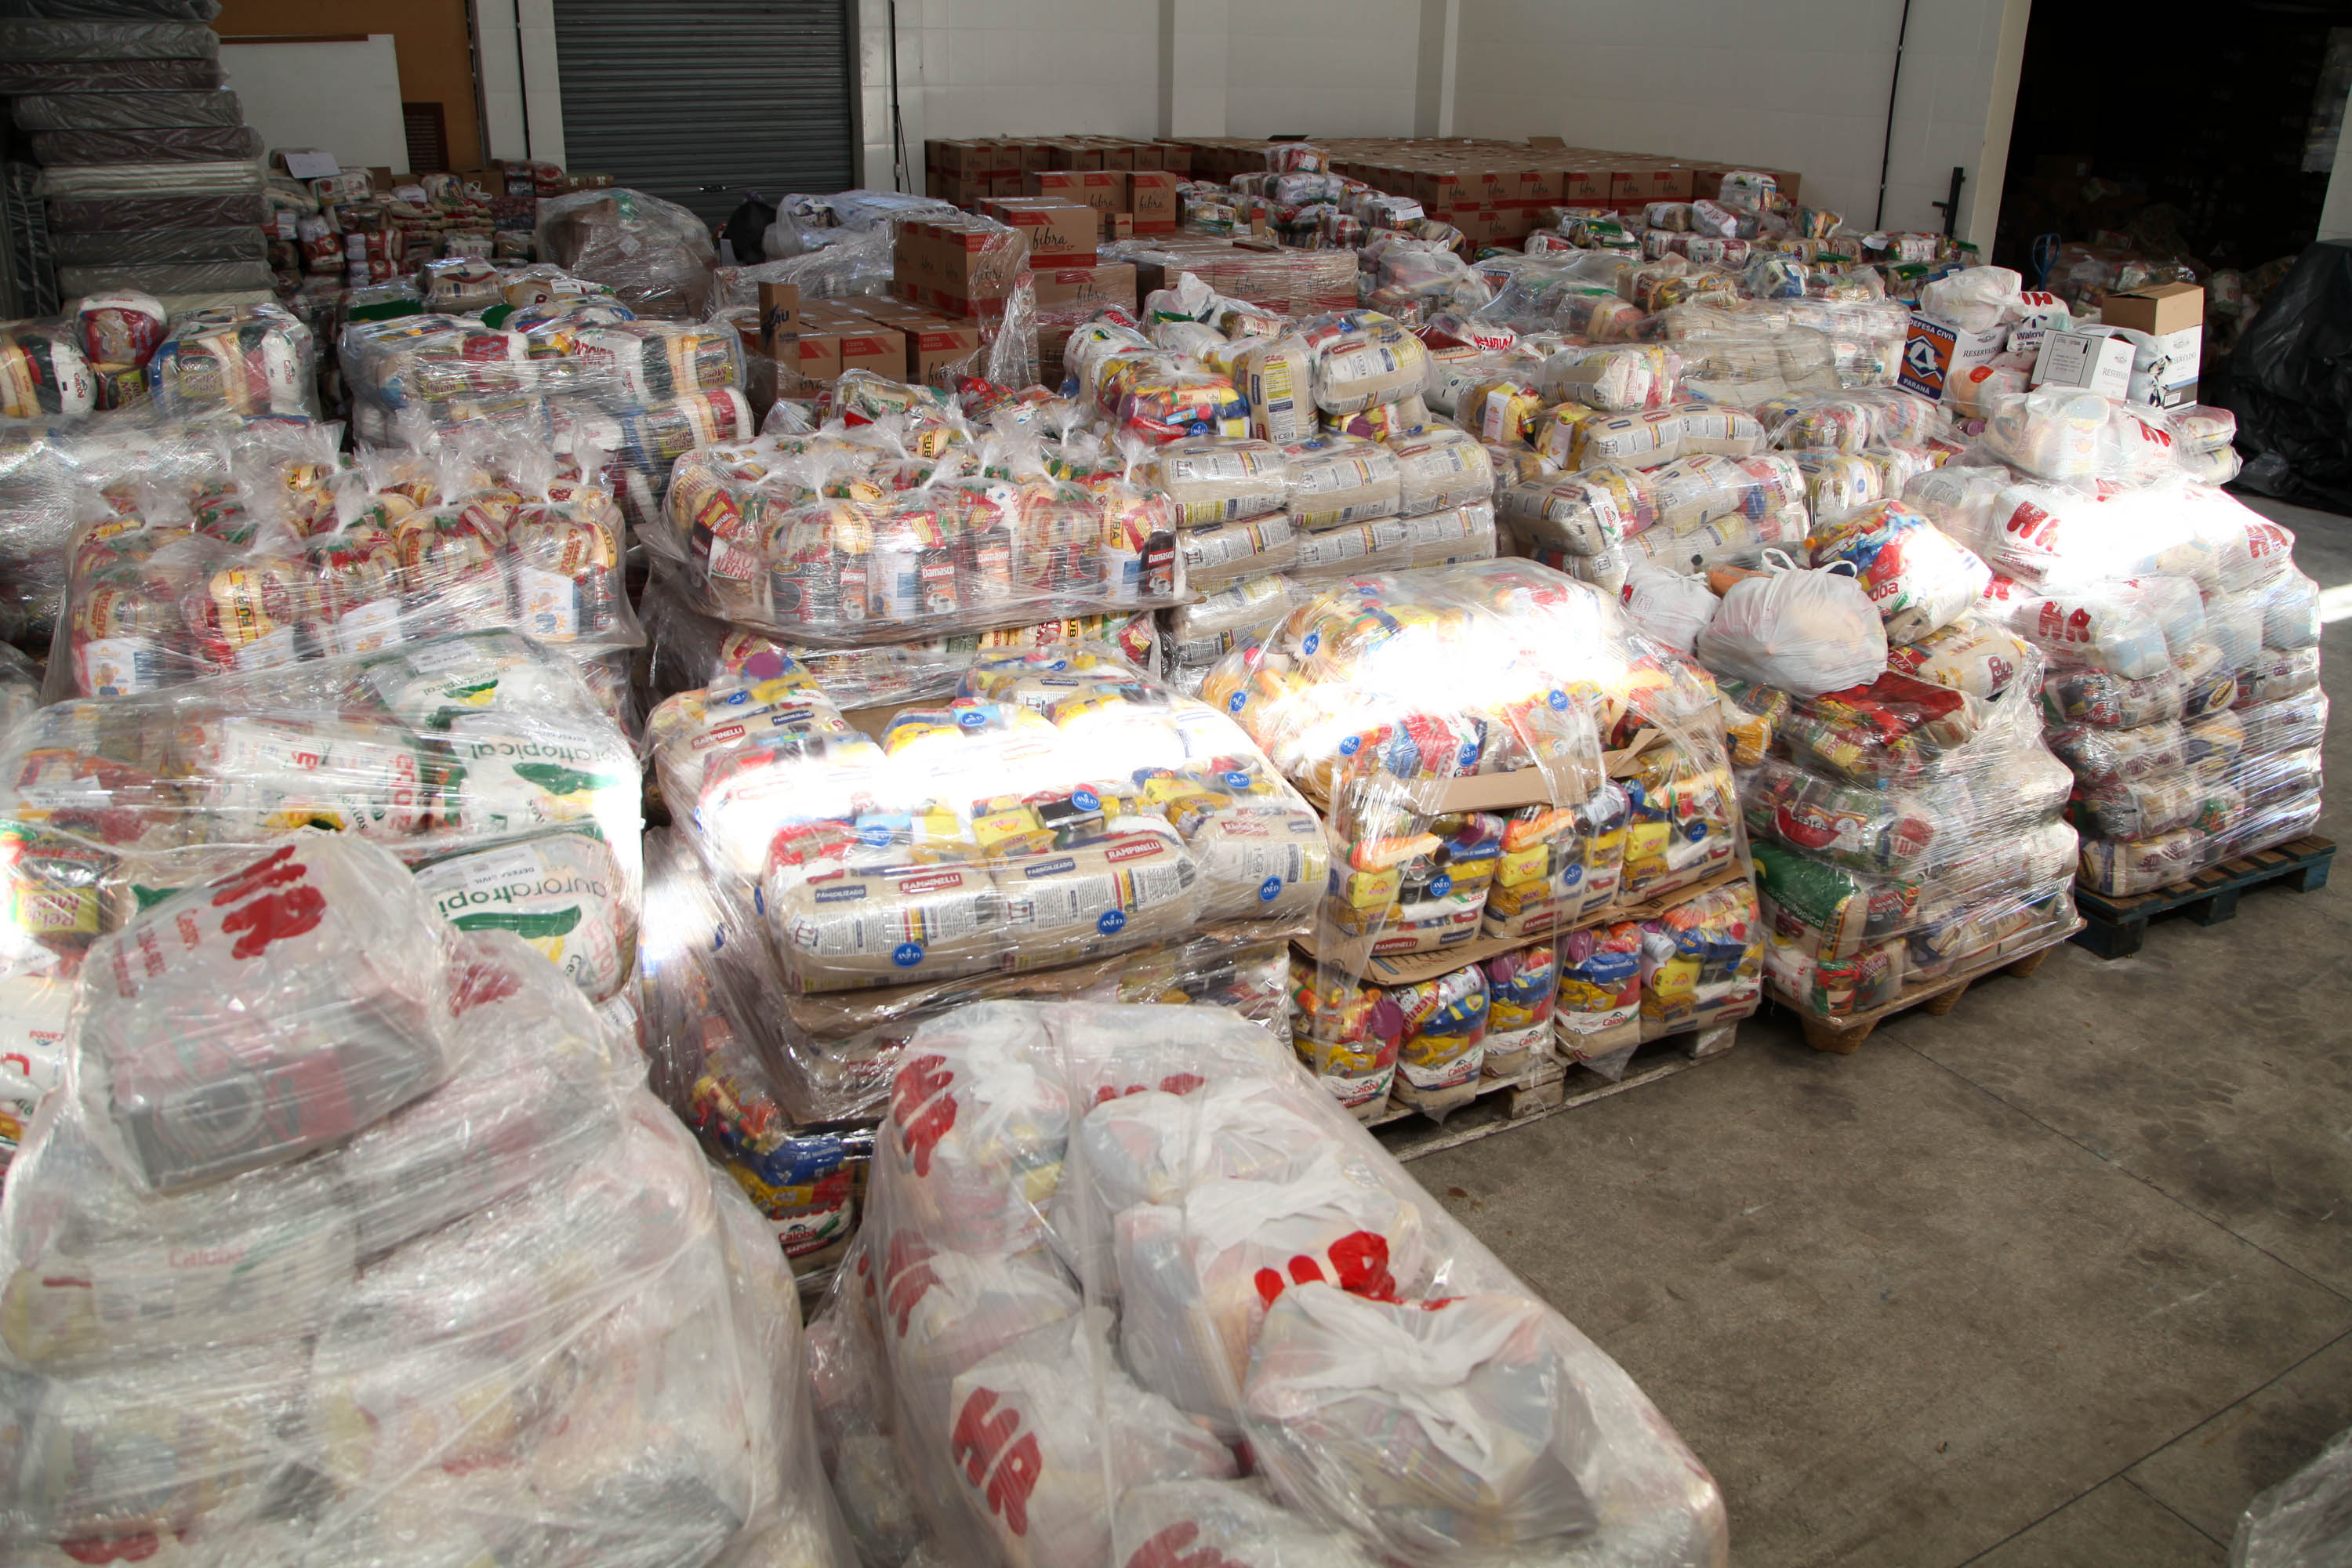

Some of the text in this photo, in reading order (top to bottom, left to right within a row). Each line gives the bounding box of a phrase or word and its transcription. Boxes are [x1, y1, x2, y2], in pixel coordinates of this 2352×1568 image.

[1139, 195, 1163, 212] fibra
[1033, 225, 1068, 250] fibra
[1076, 285, 1109, 307] fibra
[1908, 318, 1956, 343] DEFESA CIVIL
[2016, 329, 2045, 340] Walma
[1962, 344, 2002, 358] RESERVADO
[2170, 350, 2197, 365] ESERVADO
[799, 372, 825, 390] bra
[1903, 378, 1930, 395] PARANÁ
[924, 434, 933, 458] FUB
[724, 546, 754, 570] ALTO
[978, 551, 1010, 563] Damasco
[1149, 550, 1174, 564] Damasco
[713, 555, 756, 582] ALEGRE
[922, 564, 955, 579] Damasco
[692, 726, 744, 748] RAMPINELLI
[1108, 841, 1160, 860] RAMPINELLI
[1026, 861, 1074, 876] PARBOILIZADO
[902, 874, 960, 891] RAMPINELLI
[438, 877, 608, 917] auroratropi
[1101, 917, 1123, 927] ANJUD
[1374, 940, 1417, 951] RAMPINELLI
